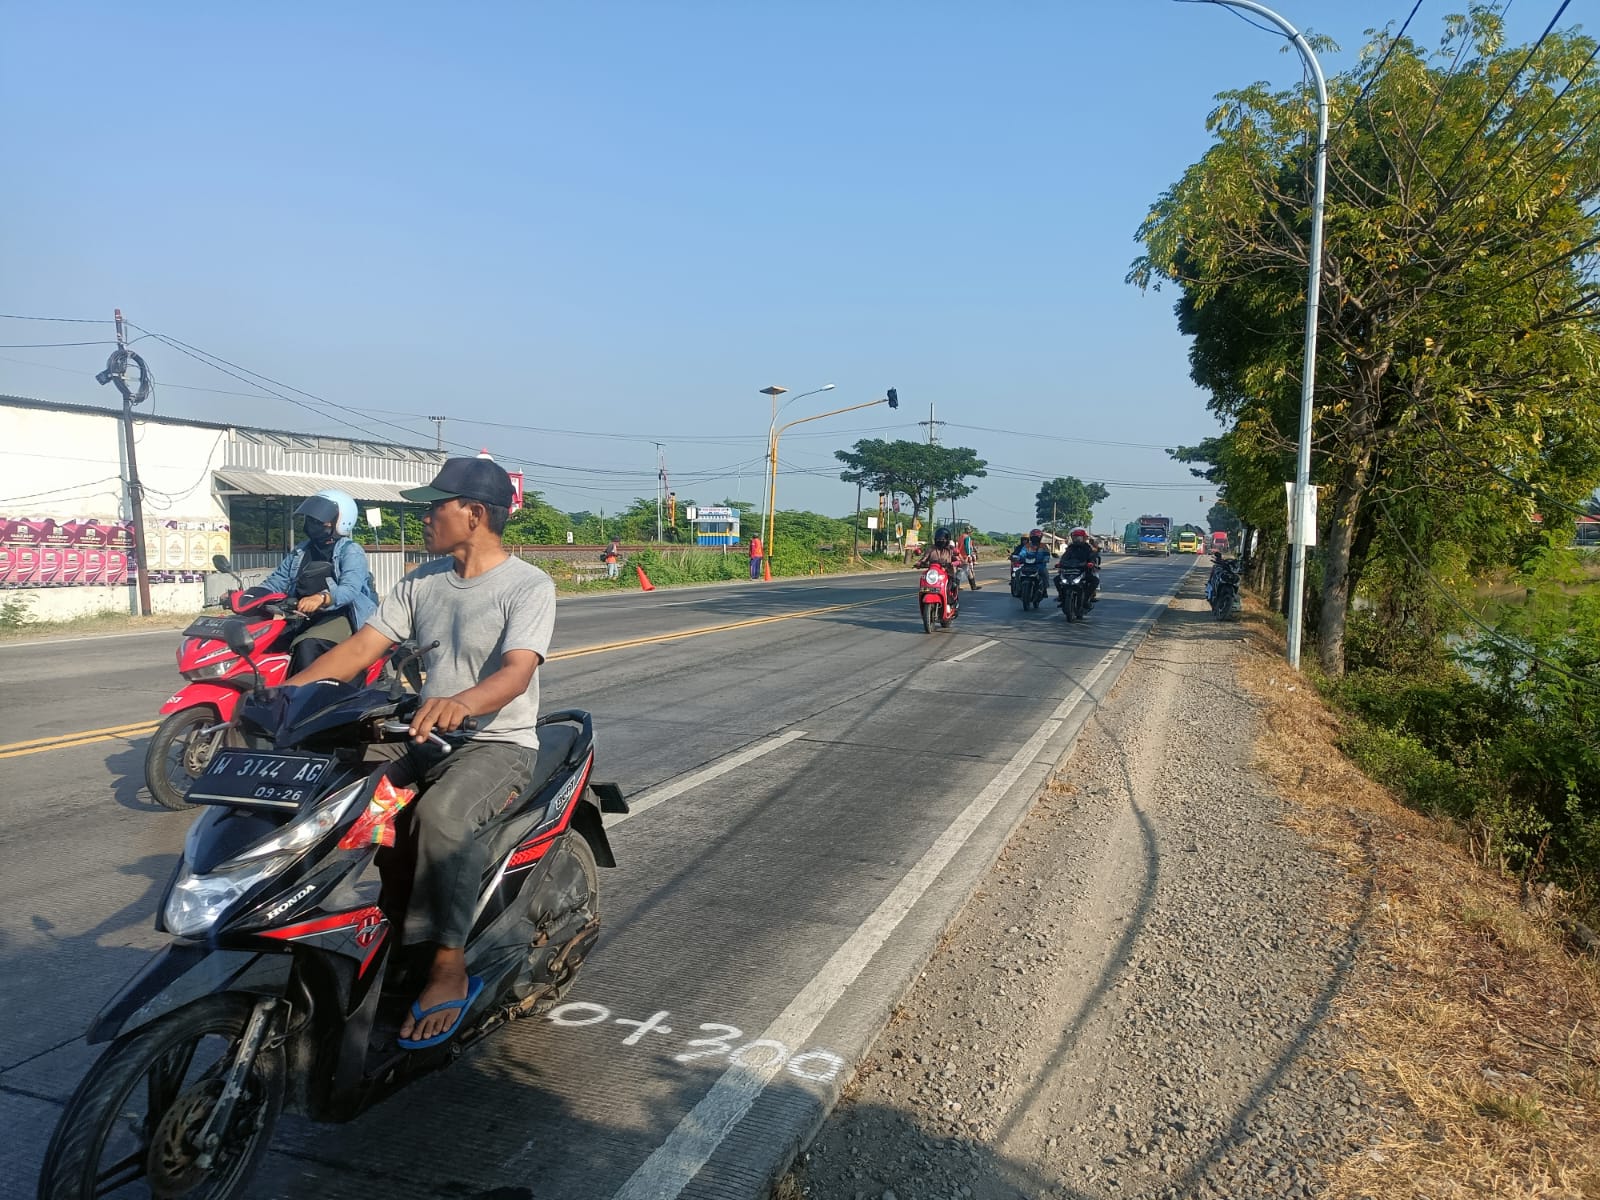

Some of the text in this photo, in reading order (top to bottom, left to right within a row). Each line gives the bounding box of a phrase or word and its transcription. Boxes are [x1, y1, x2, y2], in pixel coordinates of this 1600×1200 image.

[213, 757, 322, 782] W 3144 AG
[266, 884, 317, 920] HONDA
